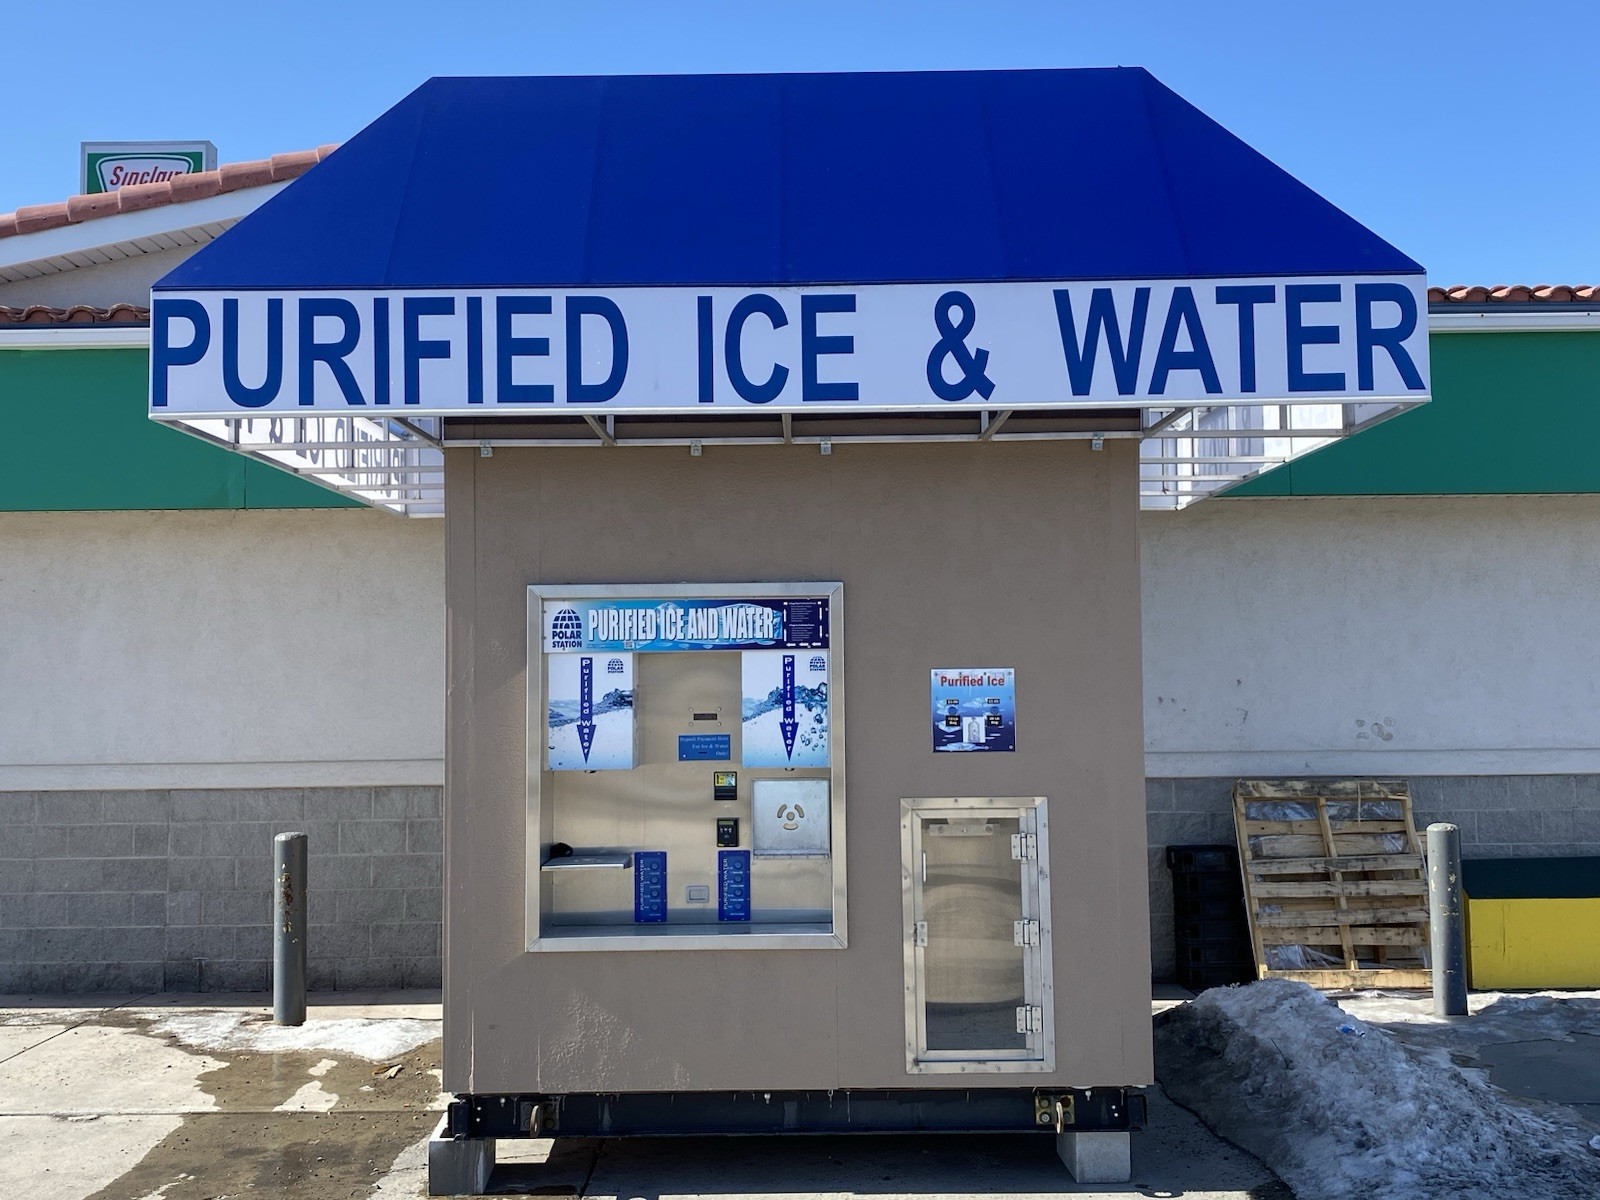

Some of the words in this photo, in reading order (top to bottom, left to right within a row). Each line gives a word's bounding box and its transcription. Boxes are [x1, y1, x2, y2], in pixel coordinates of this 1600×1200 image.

[110, 166, 182, 186] Sinclai
[152, 296, 629, 408] PURIFIED
[697, 293, 860, 404] ICE
[926, 290, 996, 401] &
[1052, 283, 1427, 396] WATER
[552, 630, 582, 640] POLAR
[588, 609, 657, 641] PURIFIED
[659, 608, 685, 641] ICE
[687, 608, 719, 640] AND
[722, 607, 774, 639] WATER
[552, 640, 582, 648] STATION
[582, 659, 591, 714] Purified
[784, 657, 793, 712] Purified
[940, 675, 983, 687] Purified
[987, 675, 1005, 687] Ice
[581, 720, 591, 754] Water
[784, 717, 794, 752] Water
